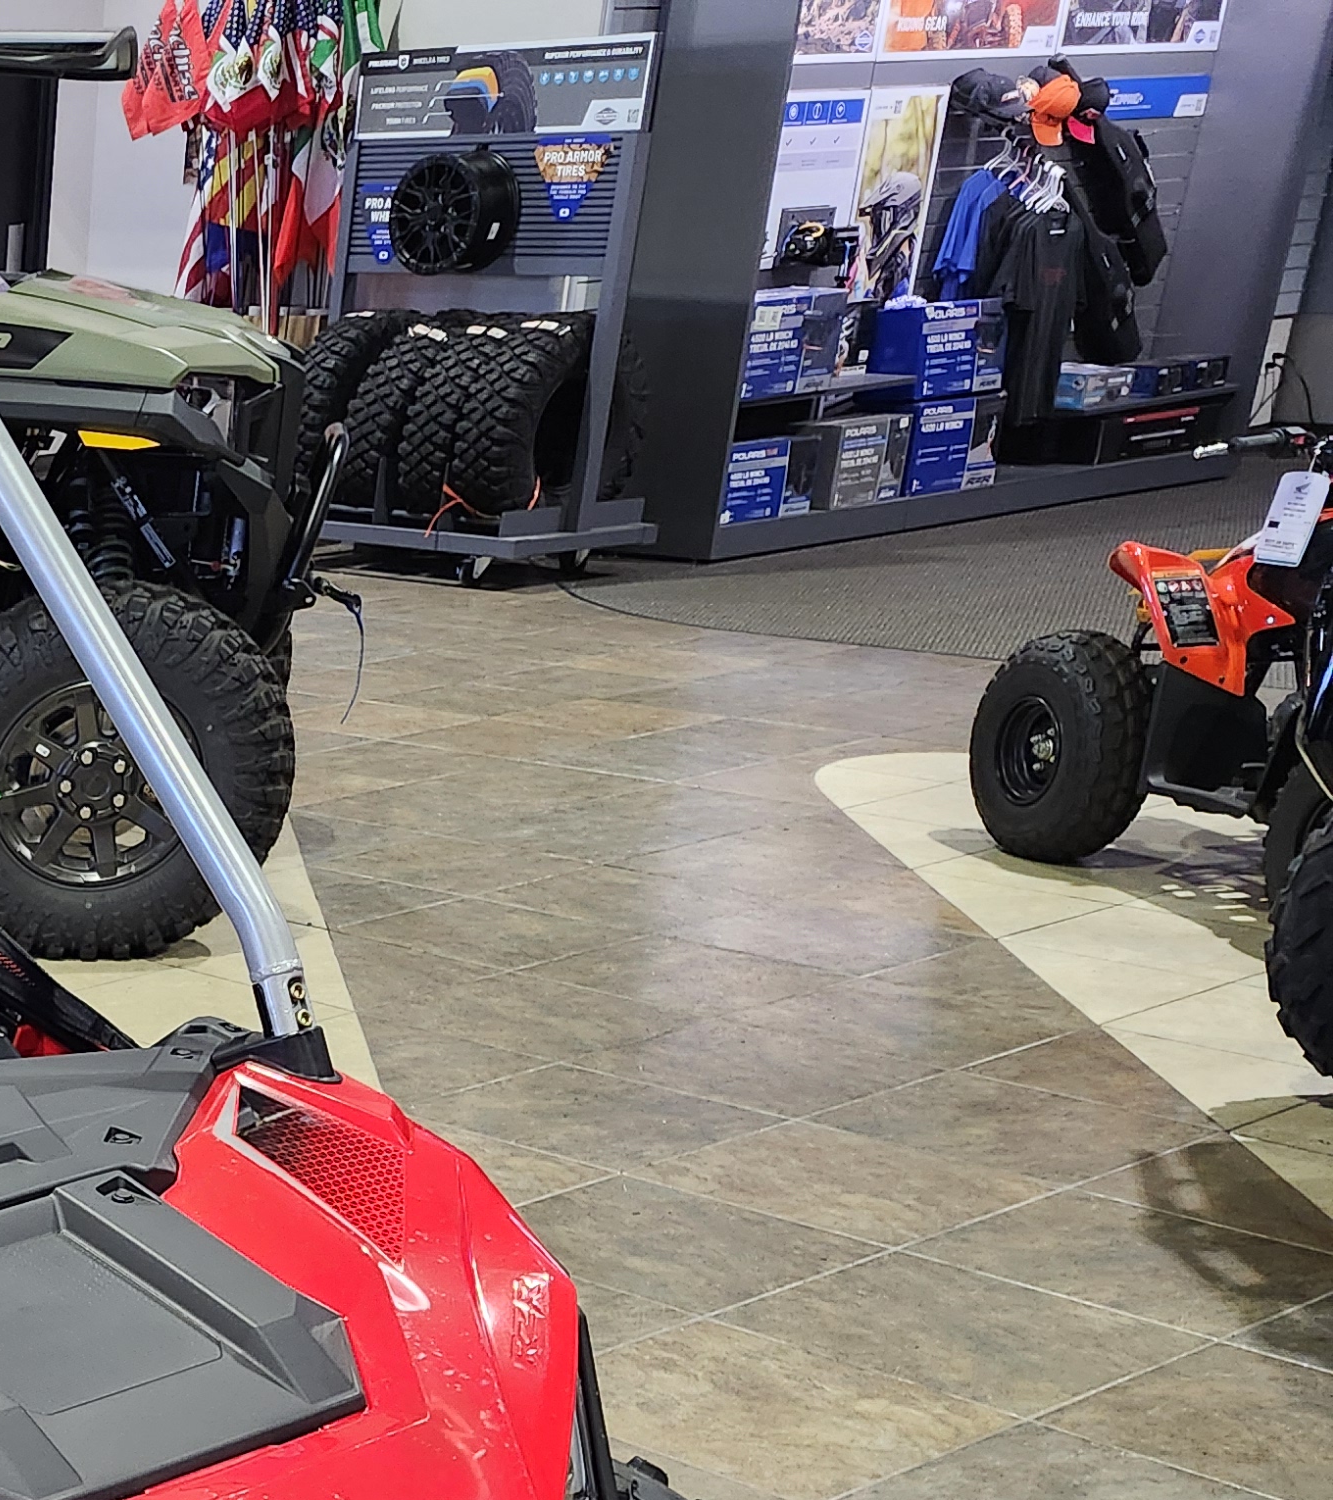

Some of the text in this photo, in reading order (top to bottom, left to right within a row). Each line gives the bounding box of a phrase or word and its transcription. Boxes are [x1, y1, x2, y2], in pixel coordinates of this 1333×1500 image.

[925, 15, 948, 31] GEAR
[1075, 12, 1110, 27] ENHANCE
[543, 150, 602, 163] PRO ARMOR
[556, 165, 586, 177] TIRES
[364, 197, 384, 209] PRO
